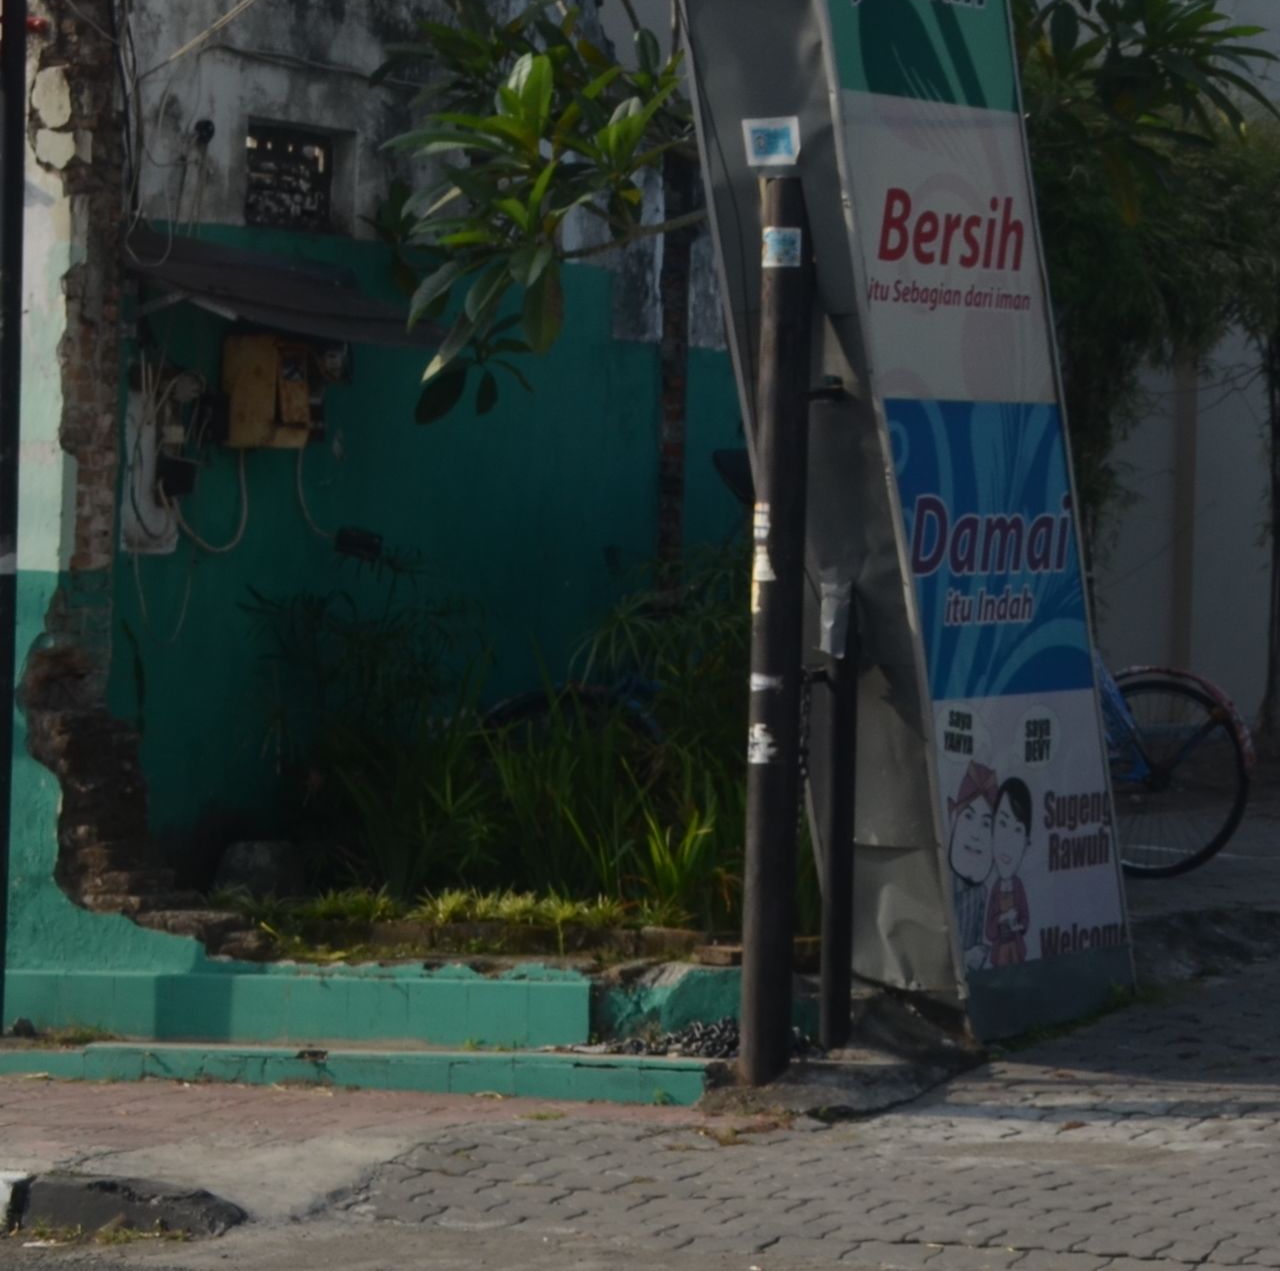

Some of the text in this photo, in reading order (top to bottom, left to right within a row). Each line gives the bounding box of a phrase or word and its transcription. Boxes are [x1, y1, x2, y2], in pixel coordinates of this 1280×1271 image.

[878, 187, 1025, 272] Bersih
[867, 277, 1031, 311] itu Sebagian dari iman
[911, 492, 1073, 577] Damai
[944, 582, 1034, 626] itu Indah
[1044, 790, 1112, 829] Sugeng
[1049, 829, 1110, 872] Rawuh
